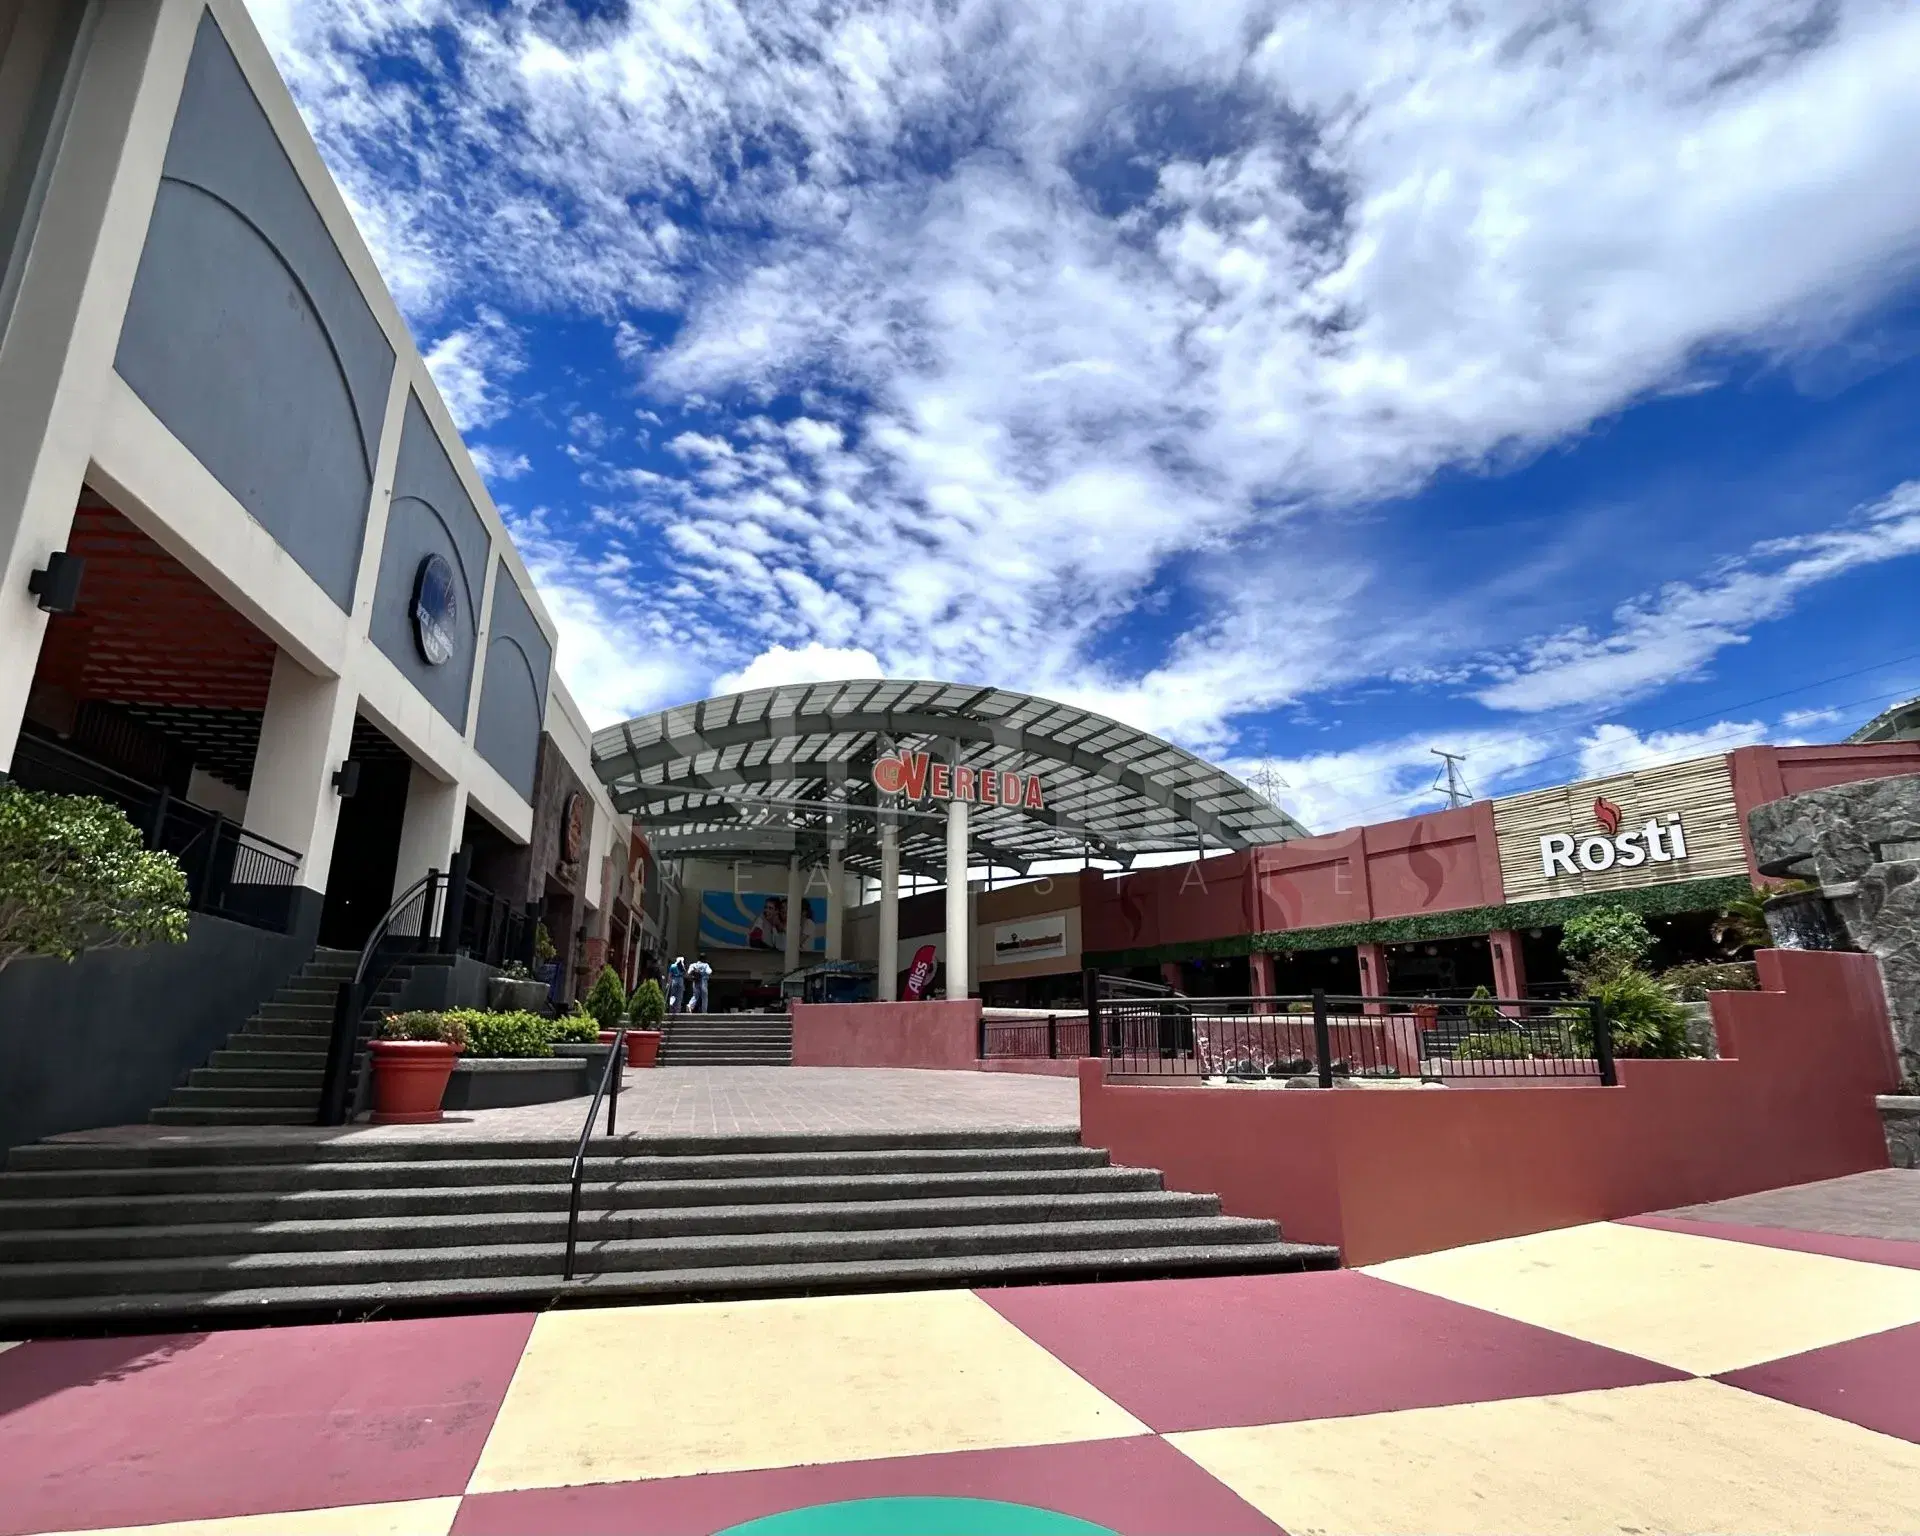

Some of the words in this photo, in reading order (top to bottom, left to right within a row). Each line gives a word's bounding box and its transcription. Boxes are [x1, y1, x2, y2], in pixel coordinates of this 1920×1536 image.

[899, 749, 1044, 810] VEREDA
[1540, 812, 1688, 878] Rosti
[908, 961, 928, 994] Aliss
